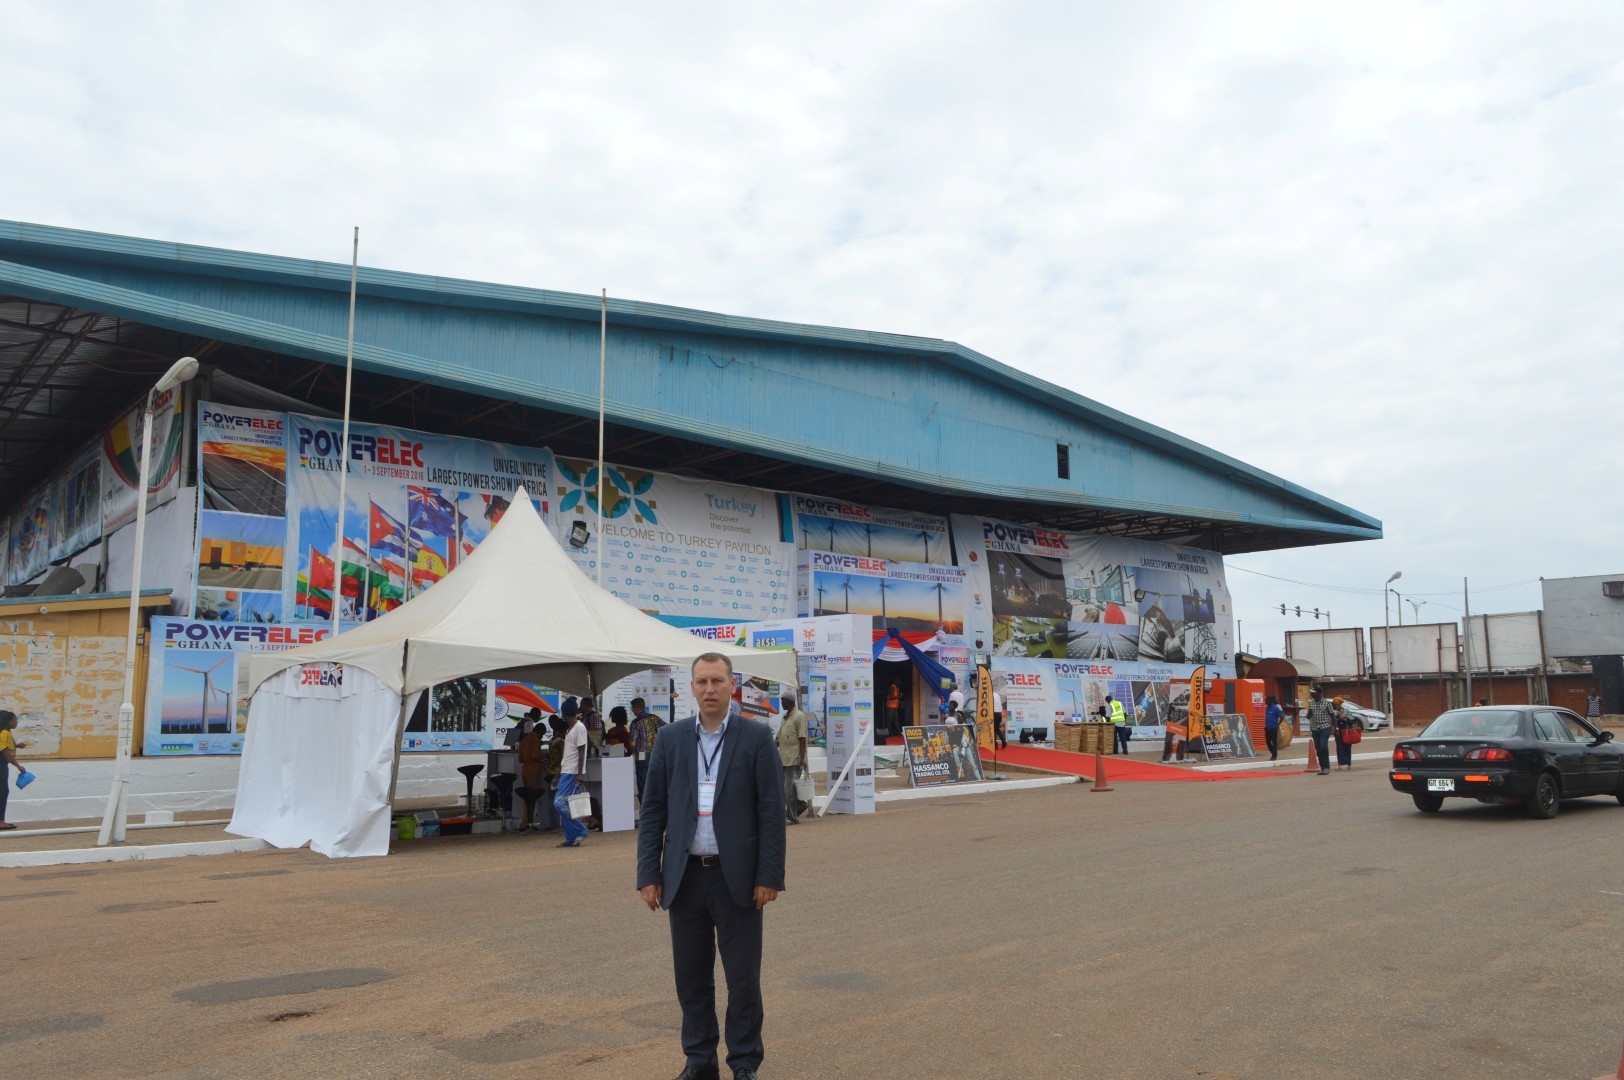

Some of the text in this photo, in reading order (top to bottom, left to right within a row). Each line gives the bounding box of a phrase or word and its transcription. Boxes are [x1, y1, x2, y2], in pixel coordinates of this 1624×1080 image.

[203, 410, 284, 430] POWERELEC
[209, 421, 236, 431] GHANA
[299, 427, 424, 468] POWERELEC
[309, 456, 351, 473] GHANA
[493, 457, 547, 479] UNVEILING THE
[376, 466, 410, 479] SEPTEMBER
[410, 470, 424, 480] 2016
[426, 467, 462, 486] LARGEST
[462, 473, 490, 490] POWER
[492, 476, 513, 492] SHOW
[522, 480, 548, 497] AFRICA
[704, 492, 757, 518] Turkey
[796, 496, 871, 517] POWERELEC
[709, 512, 738, 523] Discover
[710, 522, 722, 530] the
[593, 522, 772, 556] WELCOME TO TURKEY PAVILION
[982, 522, 1069, 550] POWERELEC
[992, 541, 1022, 552] GHANA
[814, 552, 886, 572] POWERELEC
[1140, 557, 1161, 568] LARGEST
[887, 570, 910, 580] LARGEST
[910, 572, 926, 581] POWER
[926, 574, 941, 582] SHOW
[946, 576, 963, 584] AFRICA
[166, 622, 330, 644] POWERELEC
[690, 626, 736, 639] POWERELEC
[178, 640, 233, 650] GHANA
[756, 638, 776, 647] aksa
[940, 656, 969, 664] POWERELEC
[1054, 664, 1113, 675] POWERELEC
[1006, 674, 1042, 686] RELEC
[913, 763, 949, 772] HASSANCO
